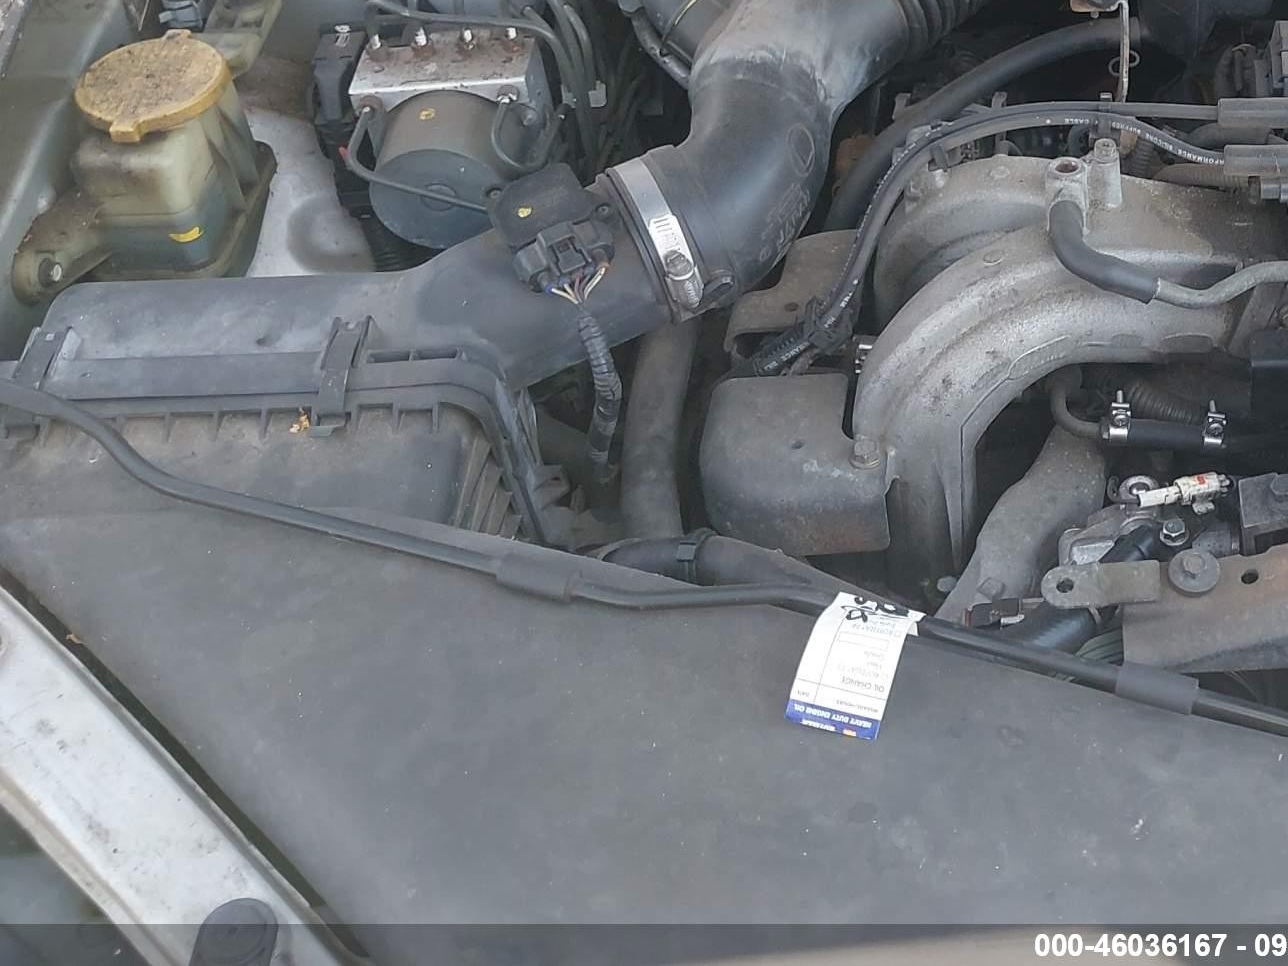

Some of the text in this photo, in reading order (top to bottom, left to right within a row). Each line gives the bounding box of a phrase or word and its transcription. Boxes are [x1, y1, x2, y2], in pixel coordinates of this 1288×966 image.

[793, 703, 805, 713] OIL
[805, 706, 831, 720] ENGINE
[832, 712, 850, 724] DUTY
[850, 716, 873, 729] HEAVY
